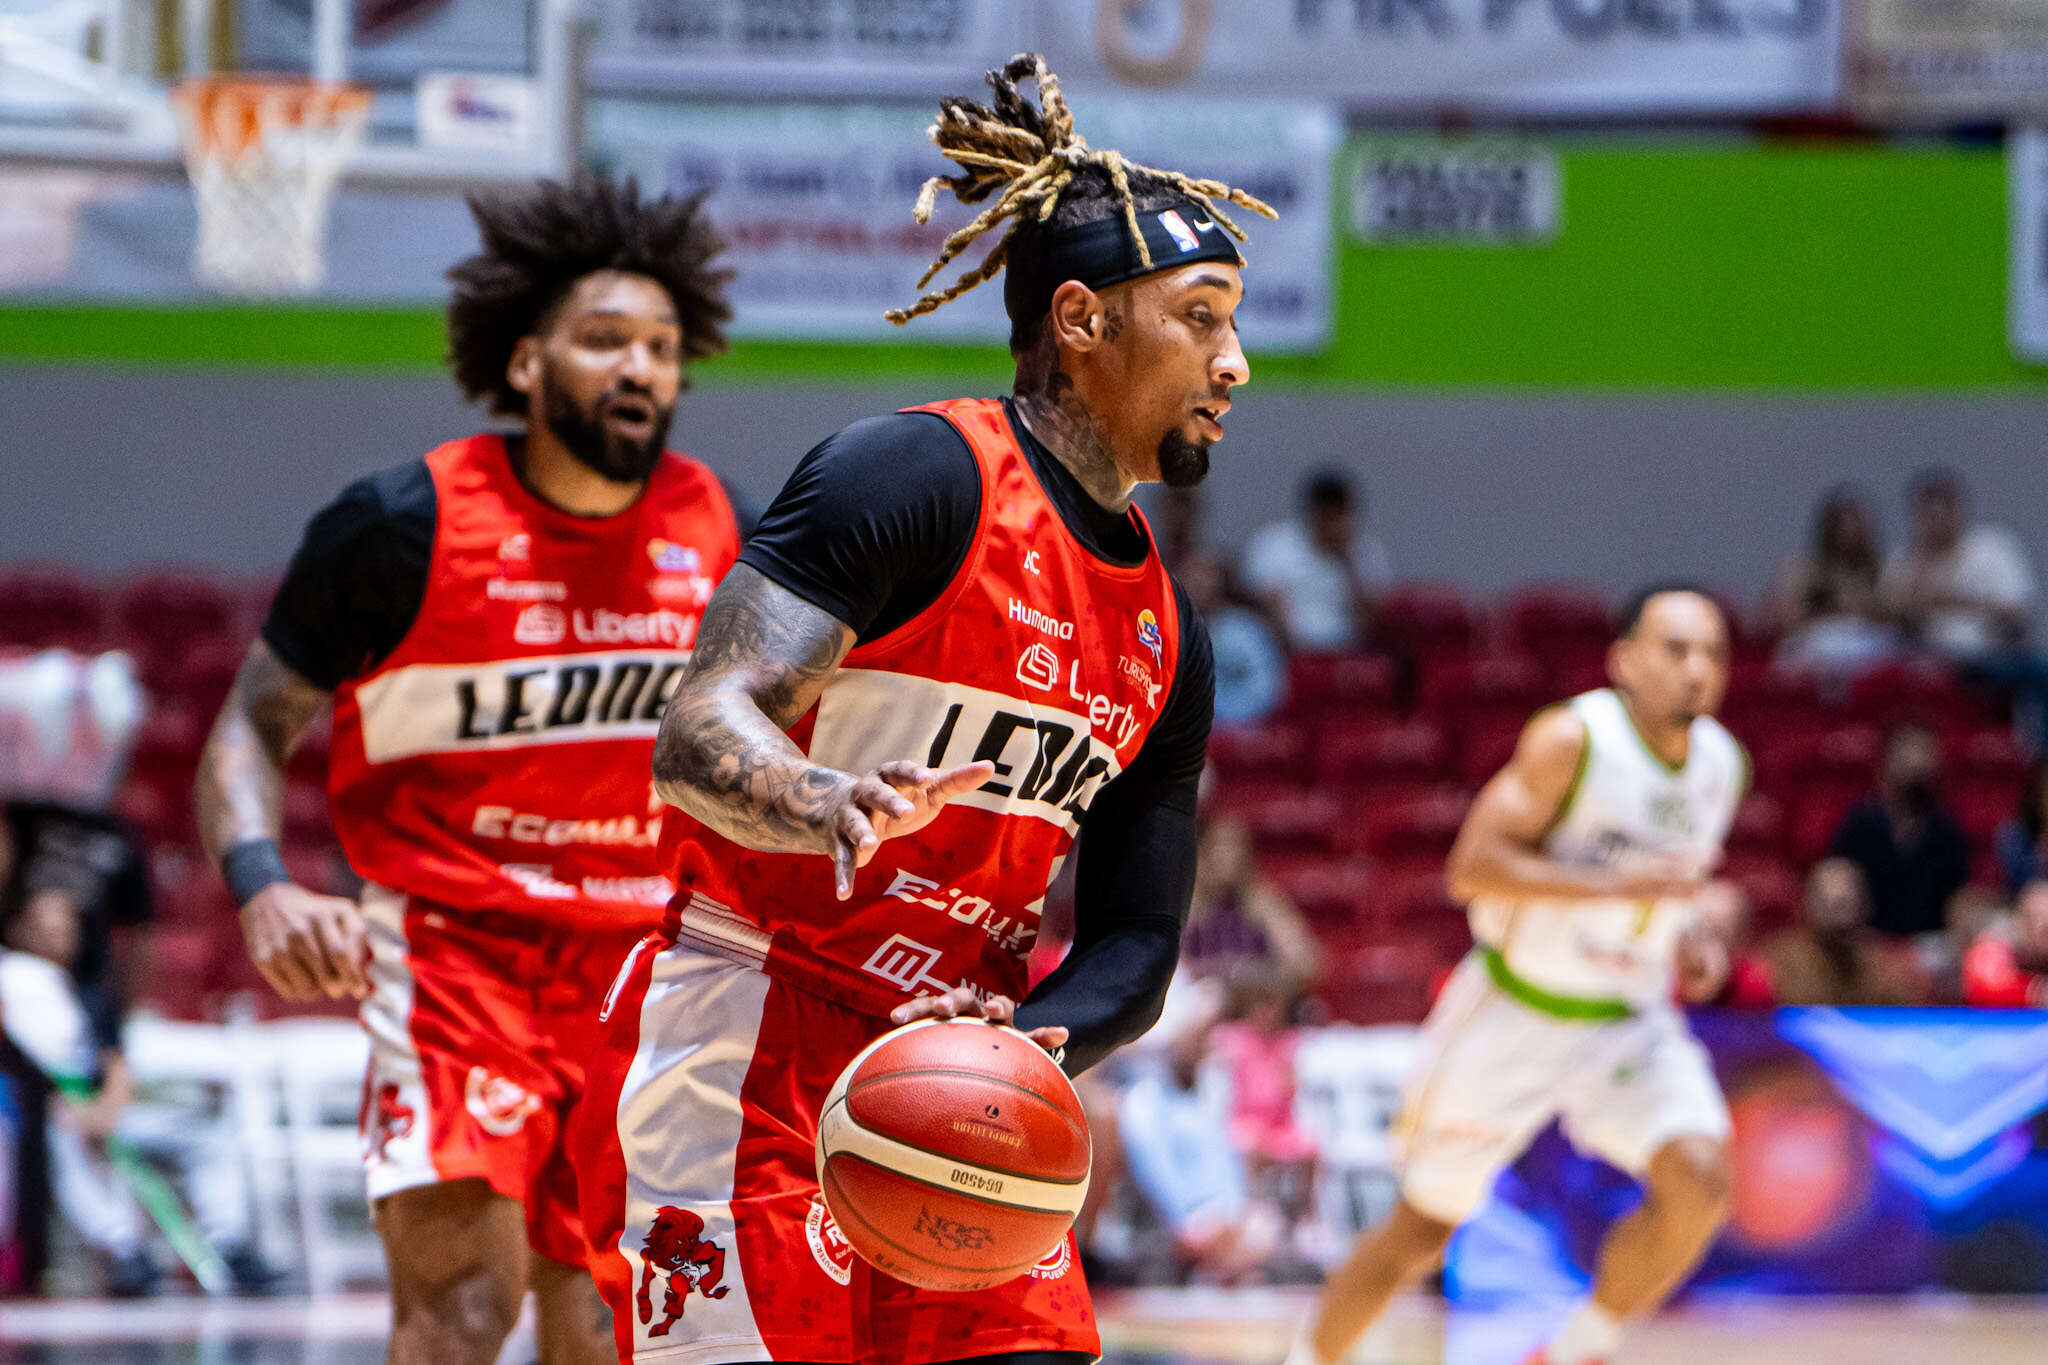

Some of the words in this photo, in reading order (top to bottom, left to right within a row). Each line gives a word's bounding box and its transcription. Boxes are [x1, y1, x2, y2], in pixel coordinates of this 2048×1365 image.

[1024, 550, 1040, 575] AC
[1008, 597, 1074, 640] Humana
[1069, 659, 1141, 750] Lerty
[951, 1168, 1004, 1195] BG4500
[1041, 1259, 1071, 1280] PUERTO
